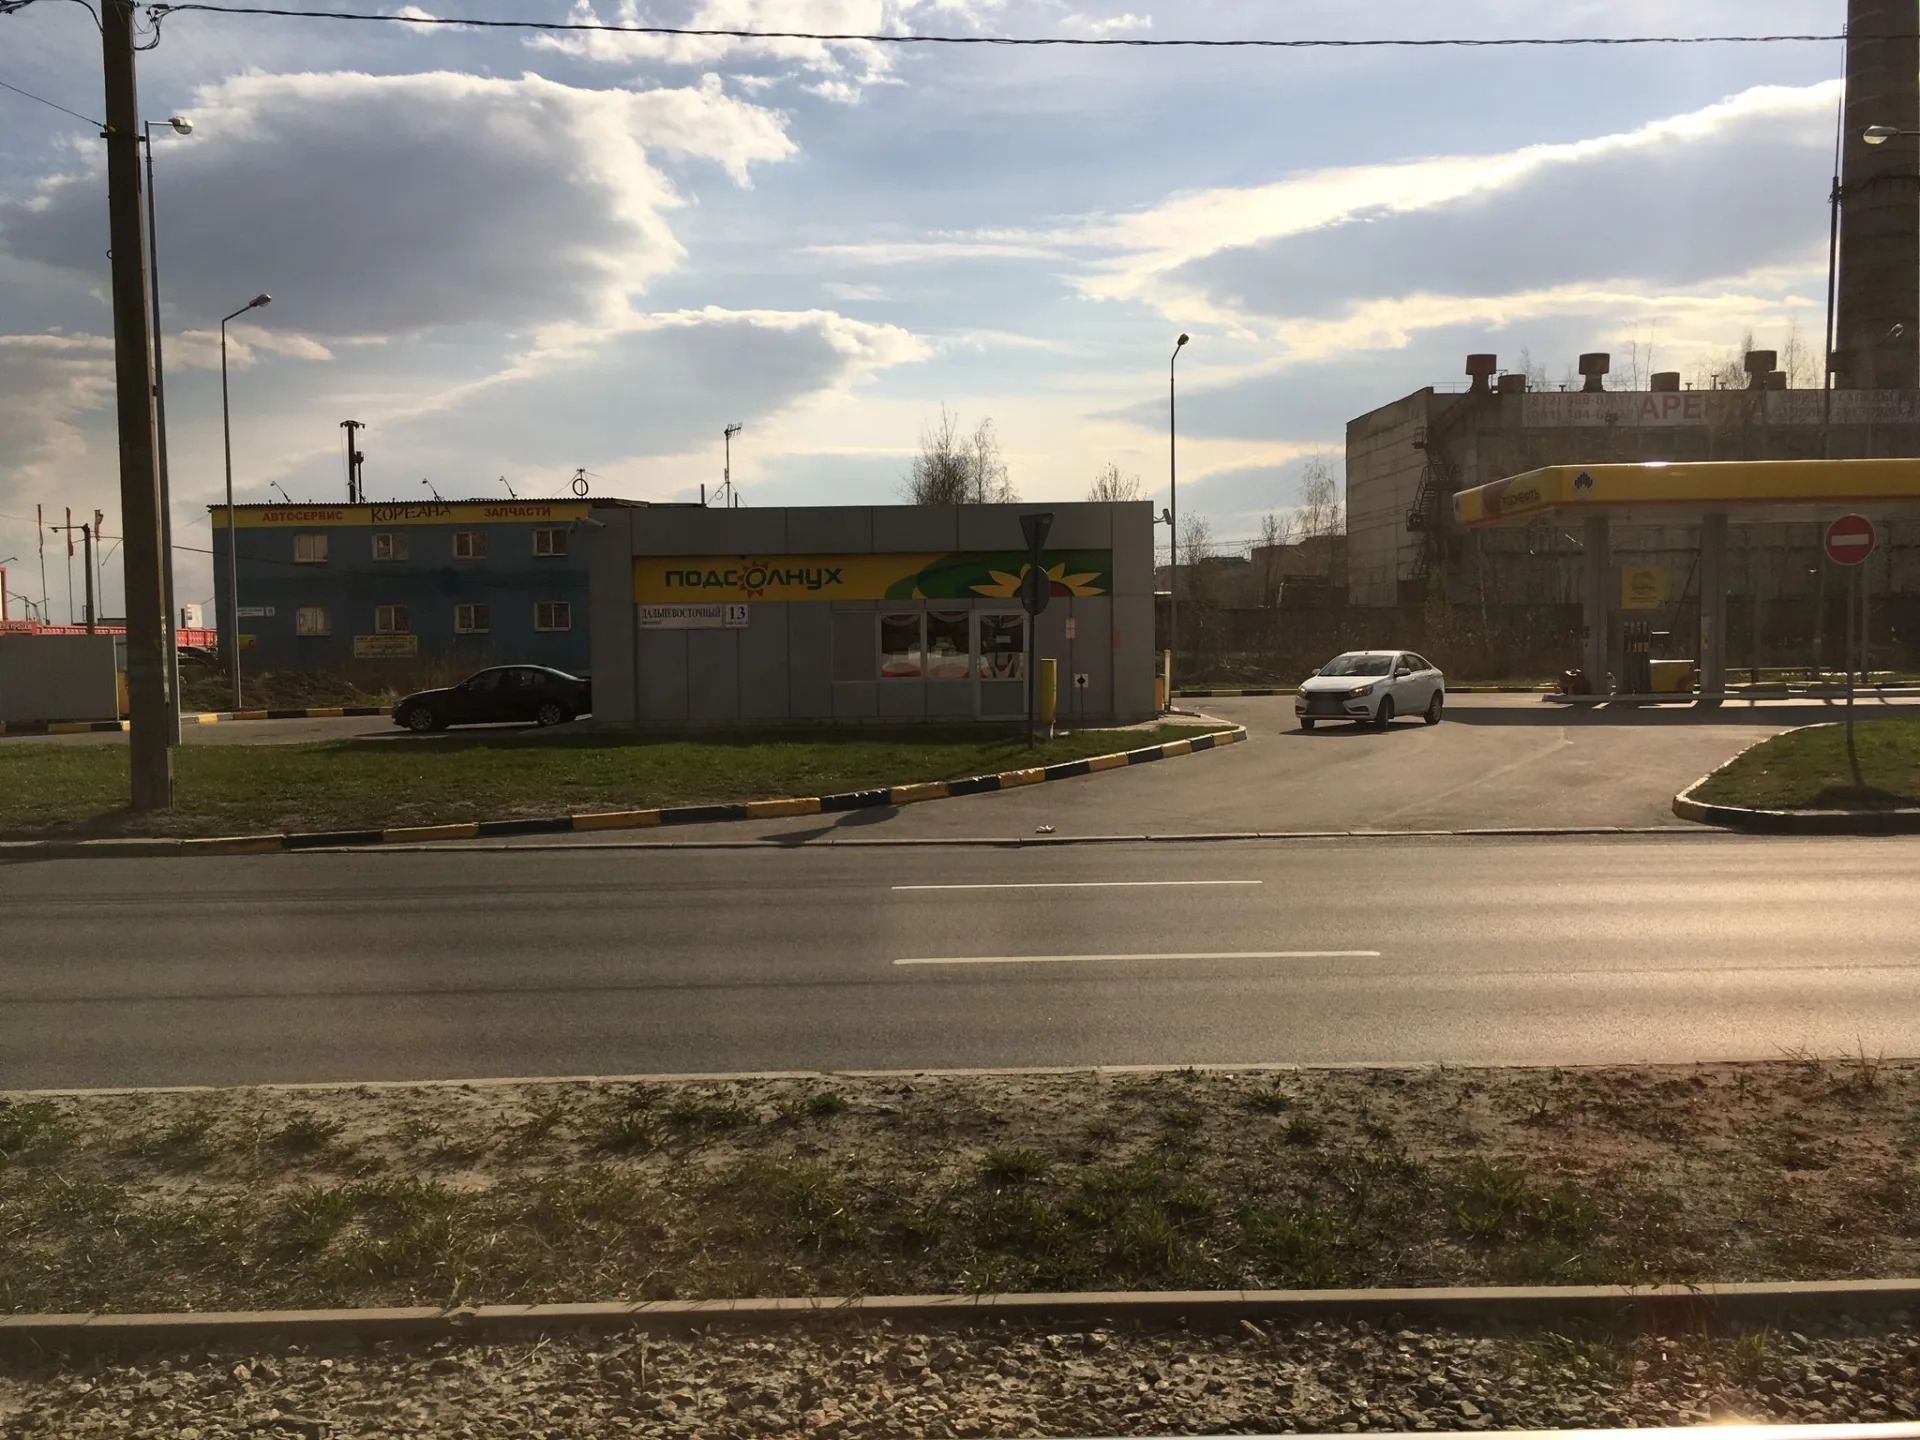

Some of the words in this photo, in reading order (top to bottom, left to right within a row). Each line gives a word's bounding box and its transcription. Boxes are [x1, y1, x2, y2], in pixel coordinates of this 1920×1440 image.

[262, 510, 344, 521] АВТОСЕРВИС
[371, 505, 452, 523] КОРЕАНА
[483, 507, 551, 517] ЗАПЧАСТИ
[665, 567, 844, 590] ПОДСОЛНУХ
[642, 606, 721, 619] ДАЛЬНЕВОСТОЧНЫЙ
[730, 606, 746, 620] 13
